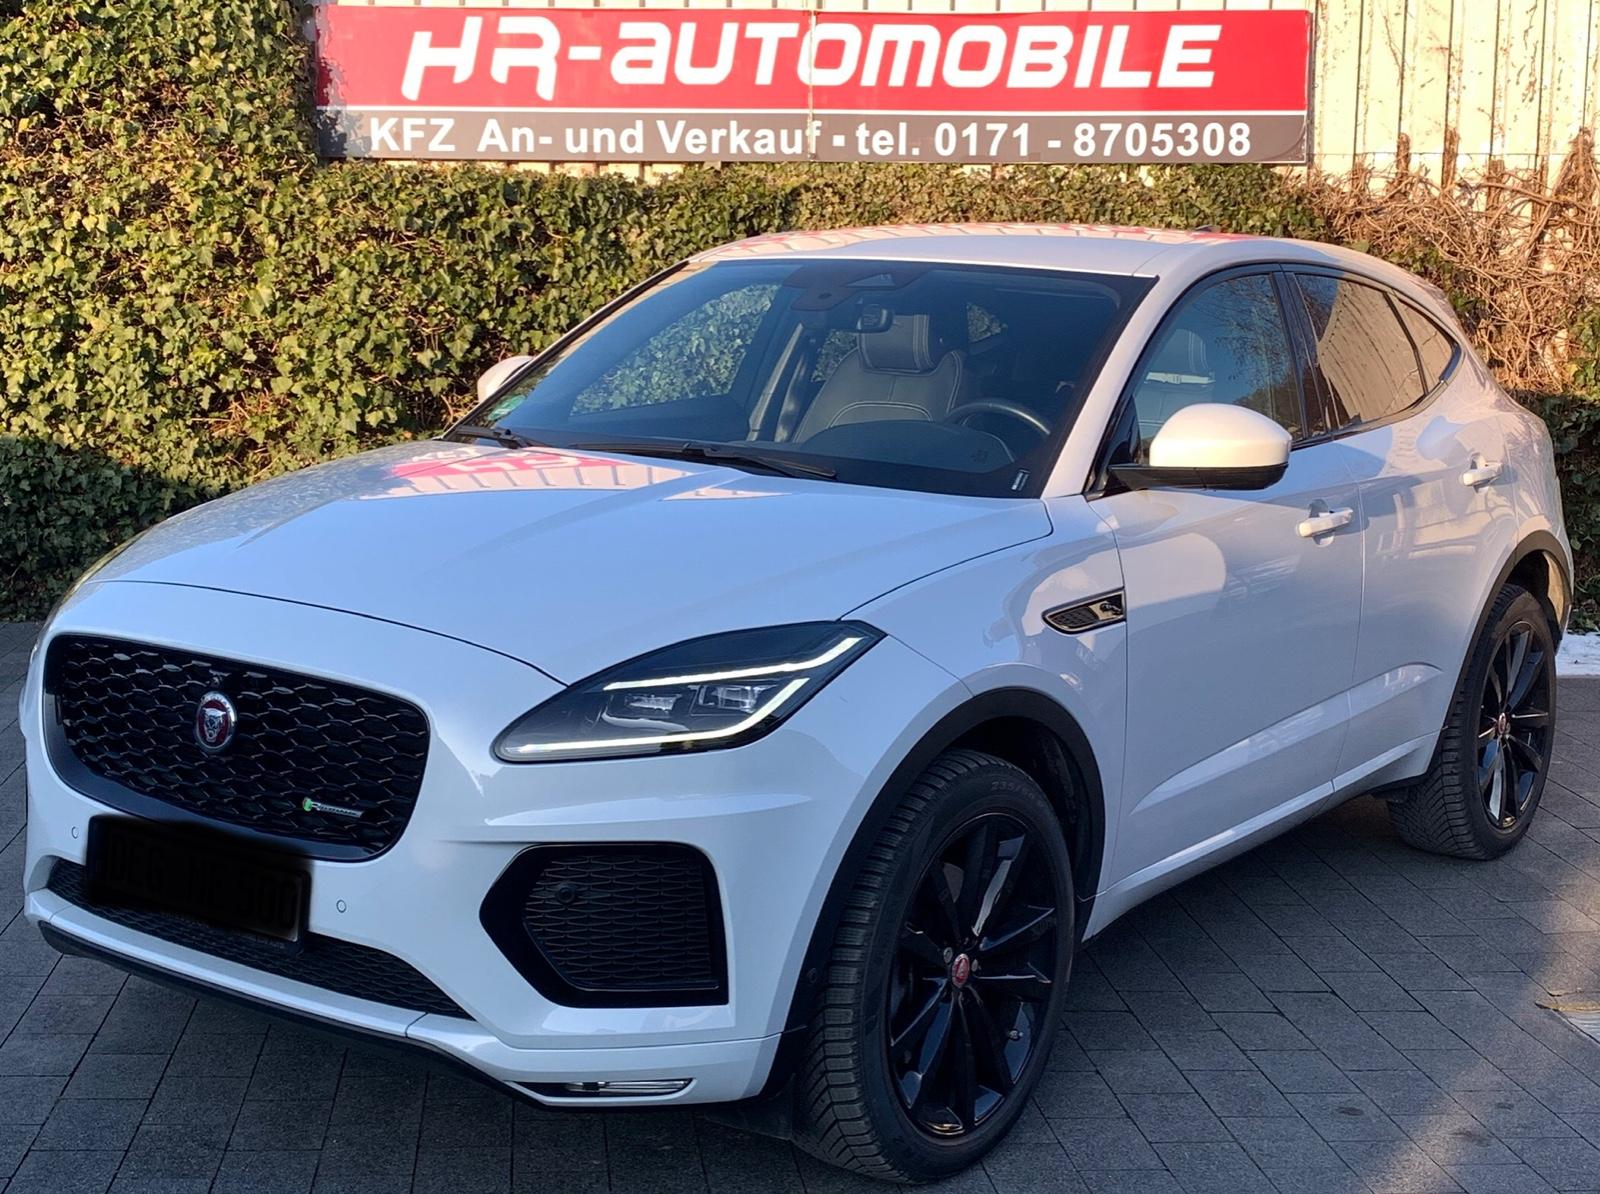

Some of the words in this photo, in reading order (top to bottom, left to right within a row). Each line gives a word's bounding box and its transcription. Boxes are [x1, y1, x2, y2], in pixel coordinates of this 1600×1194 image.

[370, 116, 456, 152] KFZ
[477, 118, 553, 153] An-
[566, 119, 644, 154] und
[656, 120, 822, 155] Verkauf
[855, 122, 920, 156] tel.
[935, 122, 1029, 157] 0171
[1073, 122, 1251, 157] 8705308
